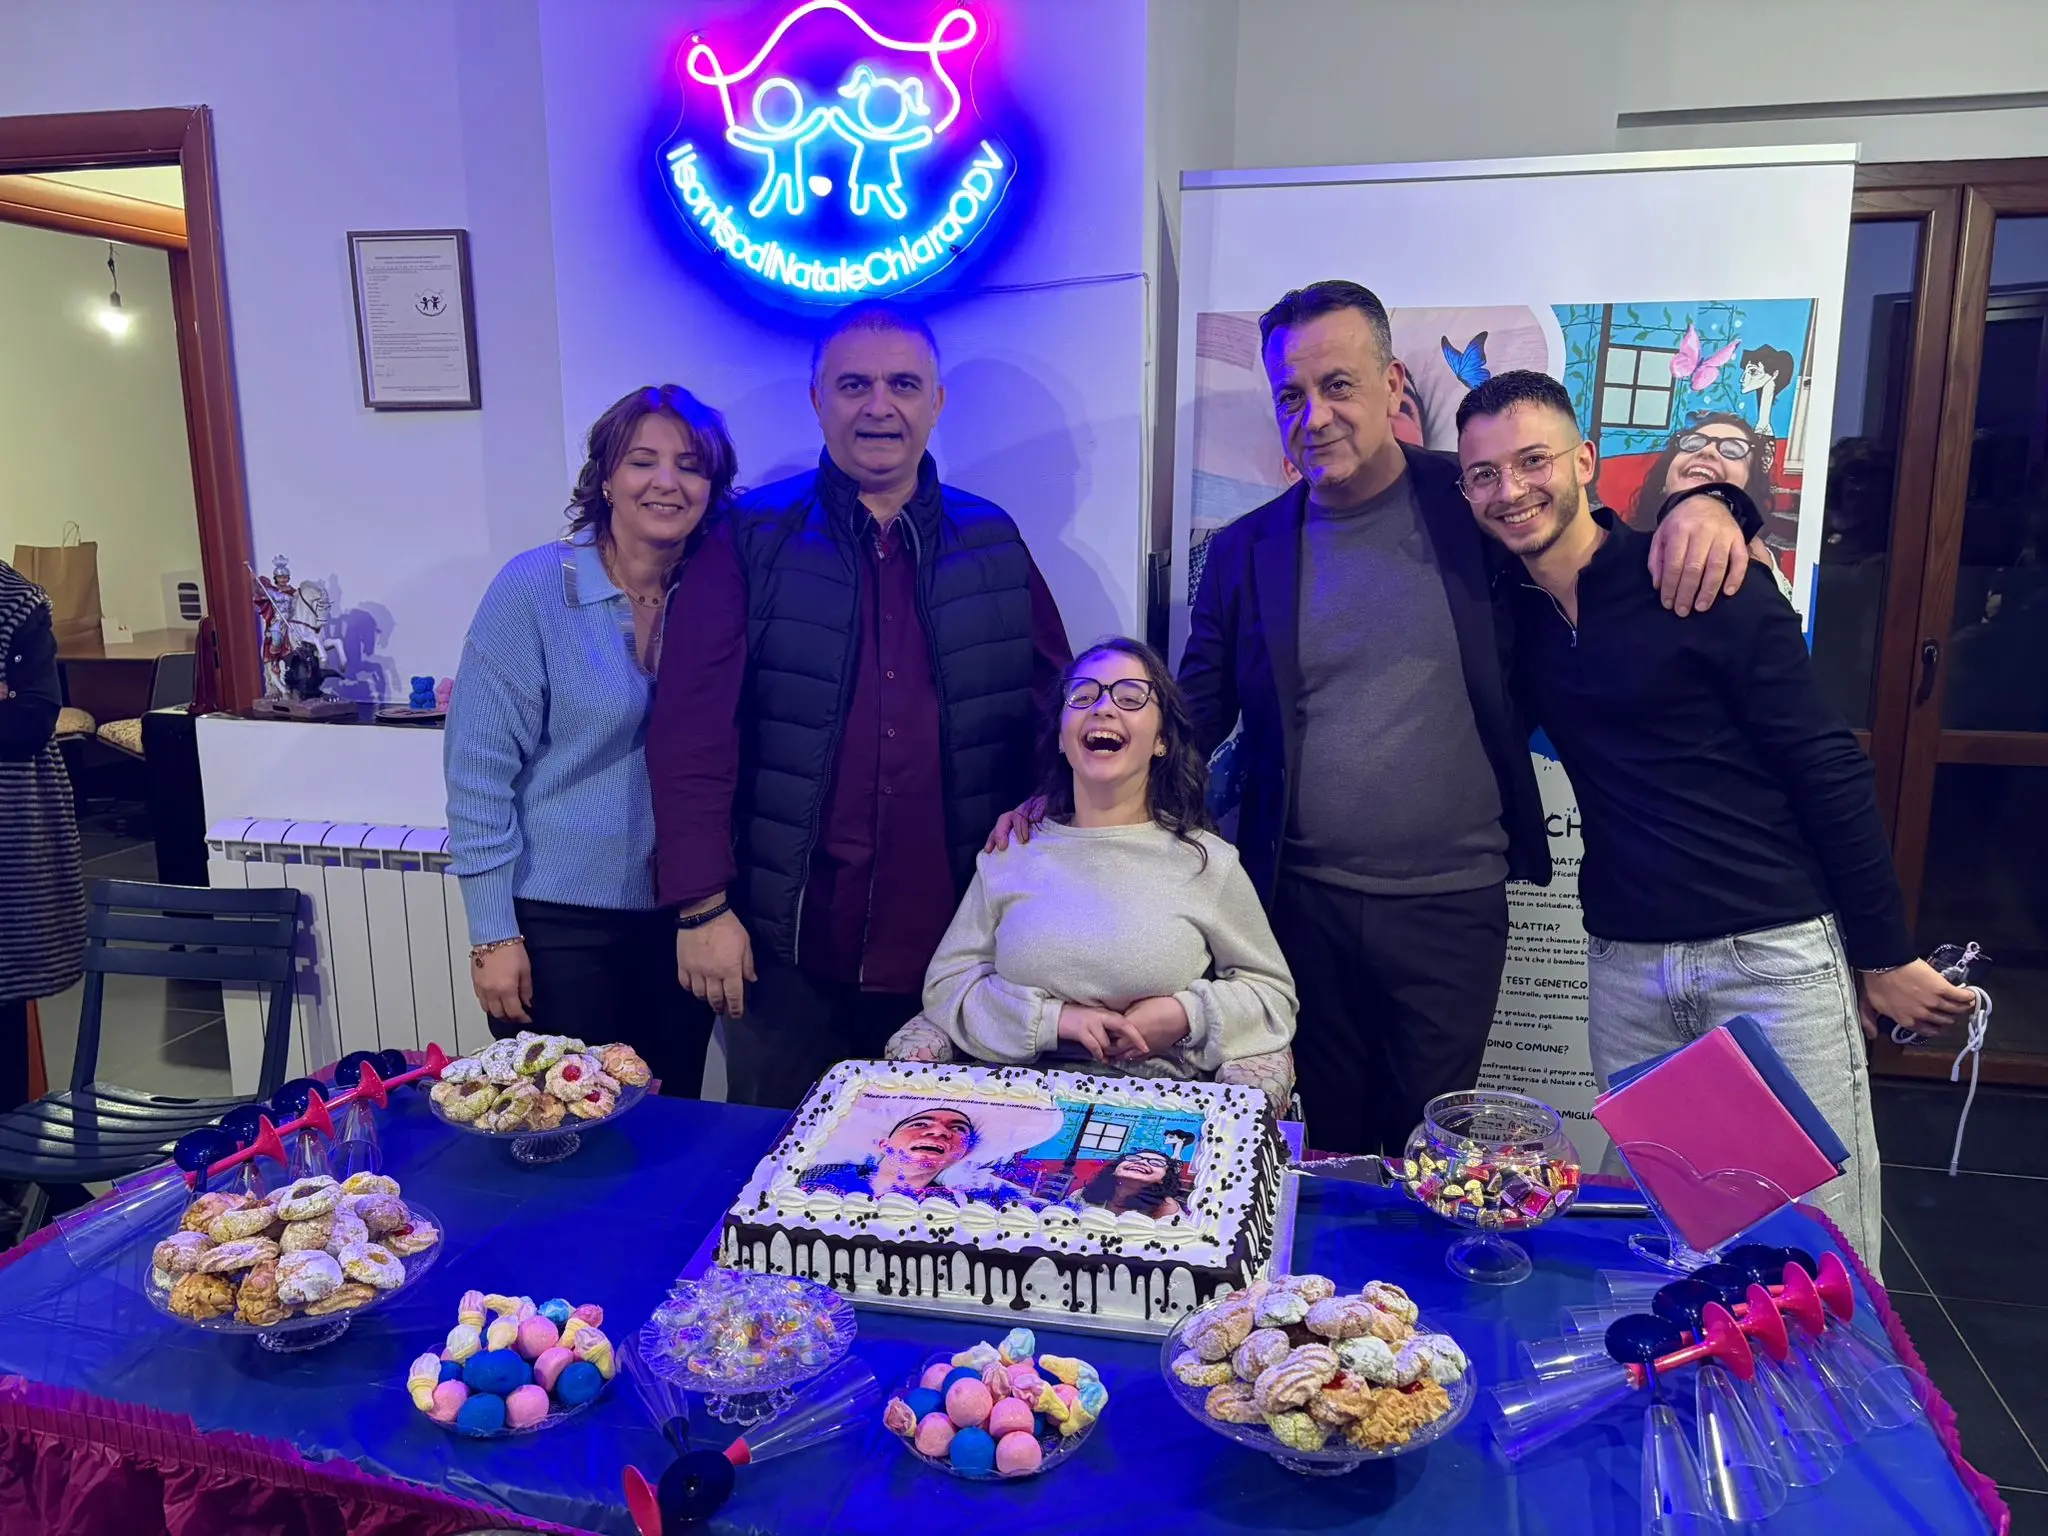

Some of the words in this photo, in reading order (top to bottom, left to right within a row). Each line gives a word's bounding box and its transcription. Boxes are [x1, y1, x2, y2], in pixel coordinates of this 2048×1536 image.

[1552, 870, 1579, 878] fficolt
[1536, 902, 1574, 910] solitudine,
[1508, 921, 1560, 934] ALATTIA?
[1546, 936, 1580, 944] chiamato
[1553, 958, 1586, 966] bambino
[1506, 976, 1531, 986] TEST
[1534, 978, 1588, 990] GENETICO
[1506, 990, 1541, 998] controllo,
[1504, 1010, 1537, 1018] gratuito,
[1539, 1012, 1574, 1020] possiamo
[1486, 1039, 1513, 1049] DINO
[1516, 1042, 1570, 1054] COMUNE?
[1482, 1062, 1526, 1072] onfrontarsi
[1550, 1069, 1576, 1077] proprio
[1512, 1074, 1540, 1084] Sorriso
[1550, 1078, 1576, 1086] Natale
[1497, 1085, 1528, 1094] privacy.
[1556, 1110, 1598, 1120] AMIGLIA
